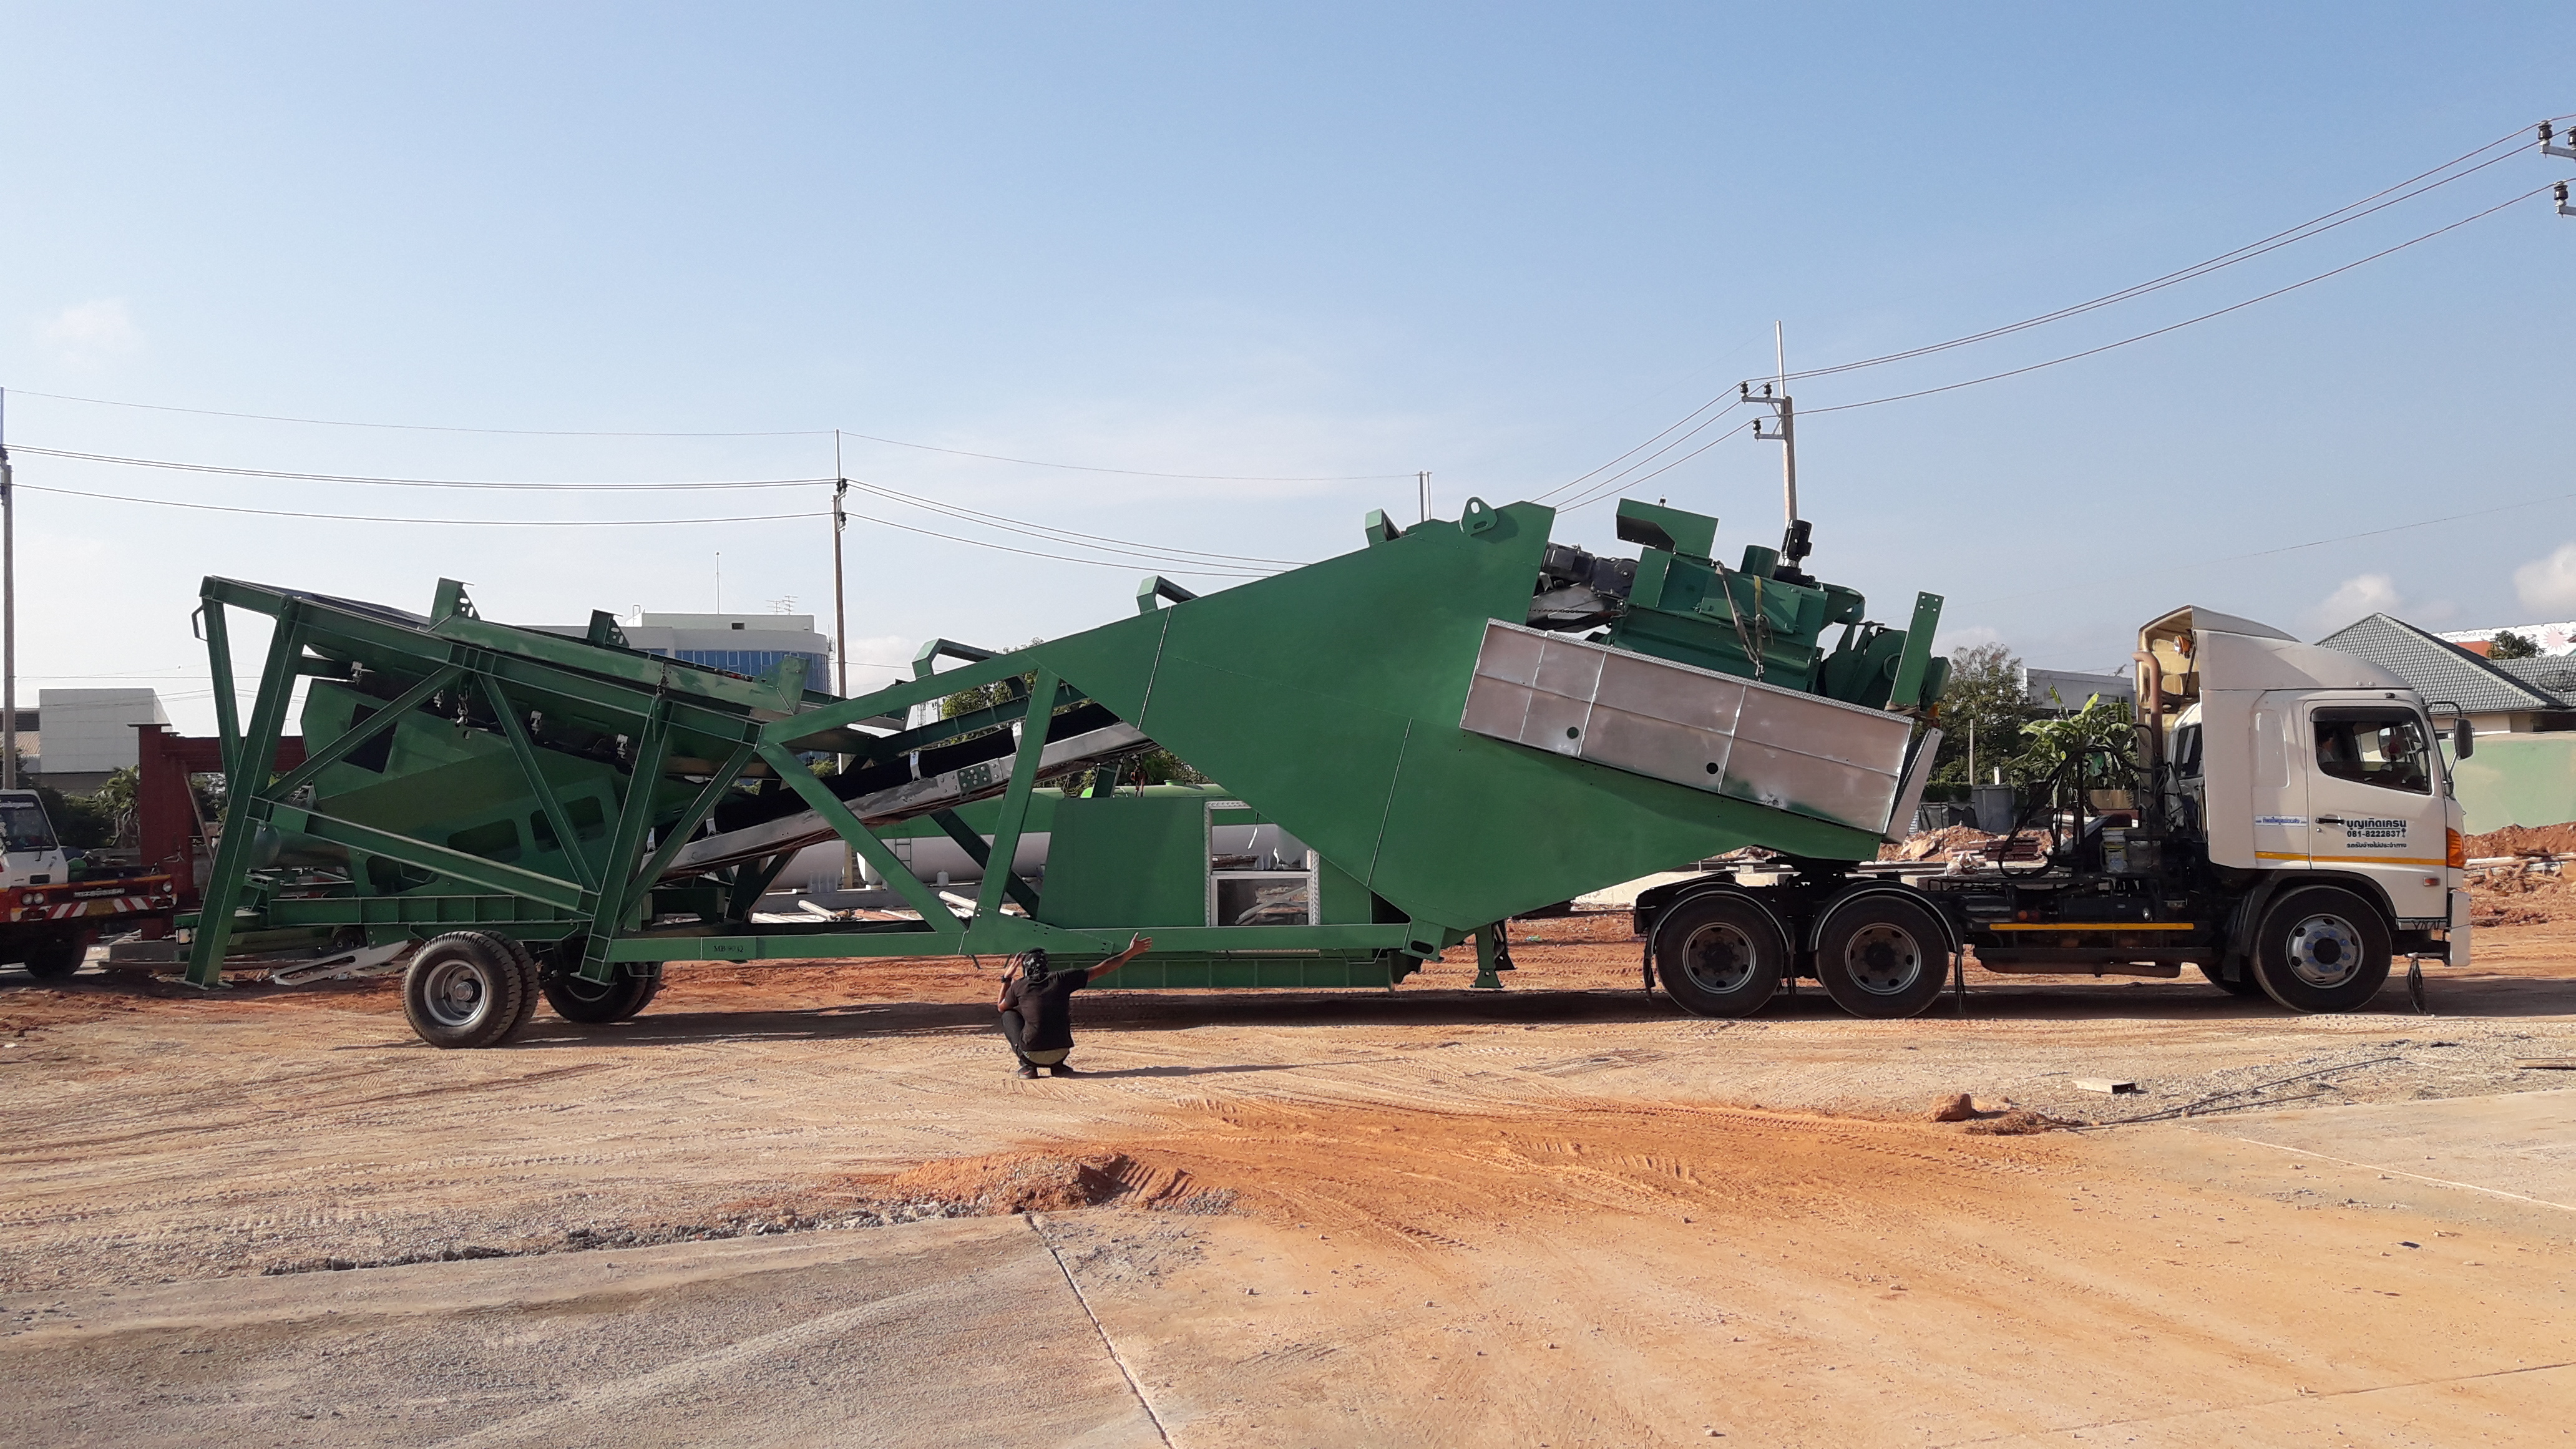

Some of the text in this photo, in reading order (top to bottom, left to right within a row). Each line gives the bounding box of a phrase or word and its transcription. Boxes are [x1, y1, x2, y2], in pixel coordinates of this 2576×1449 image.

[2346, 817, 2407, 831] บุญเกิดเครน
